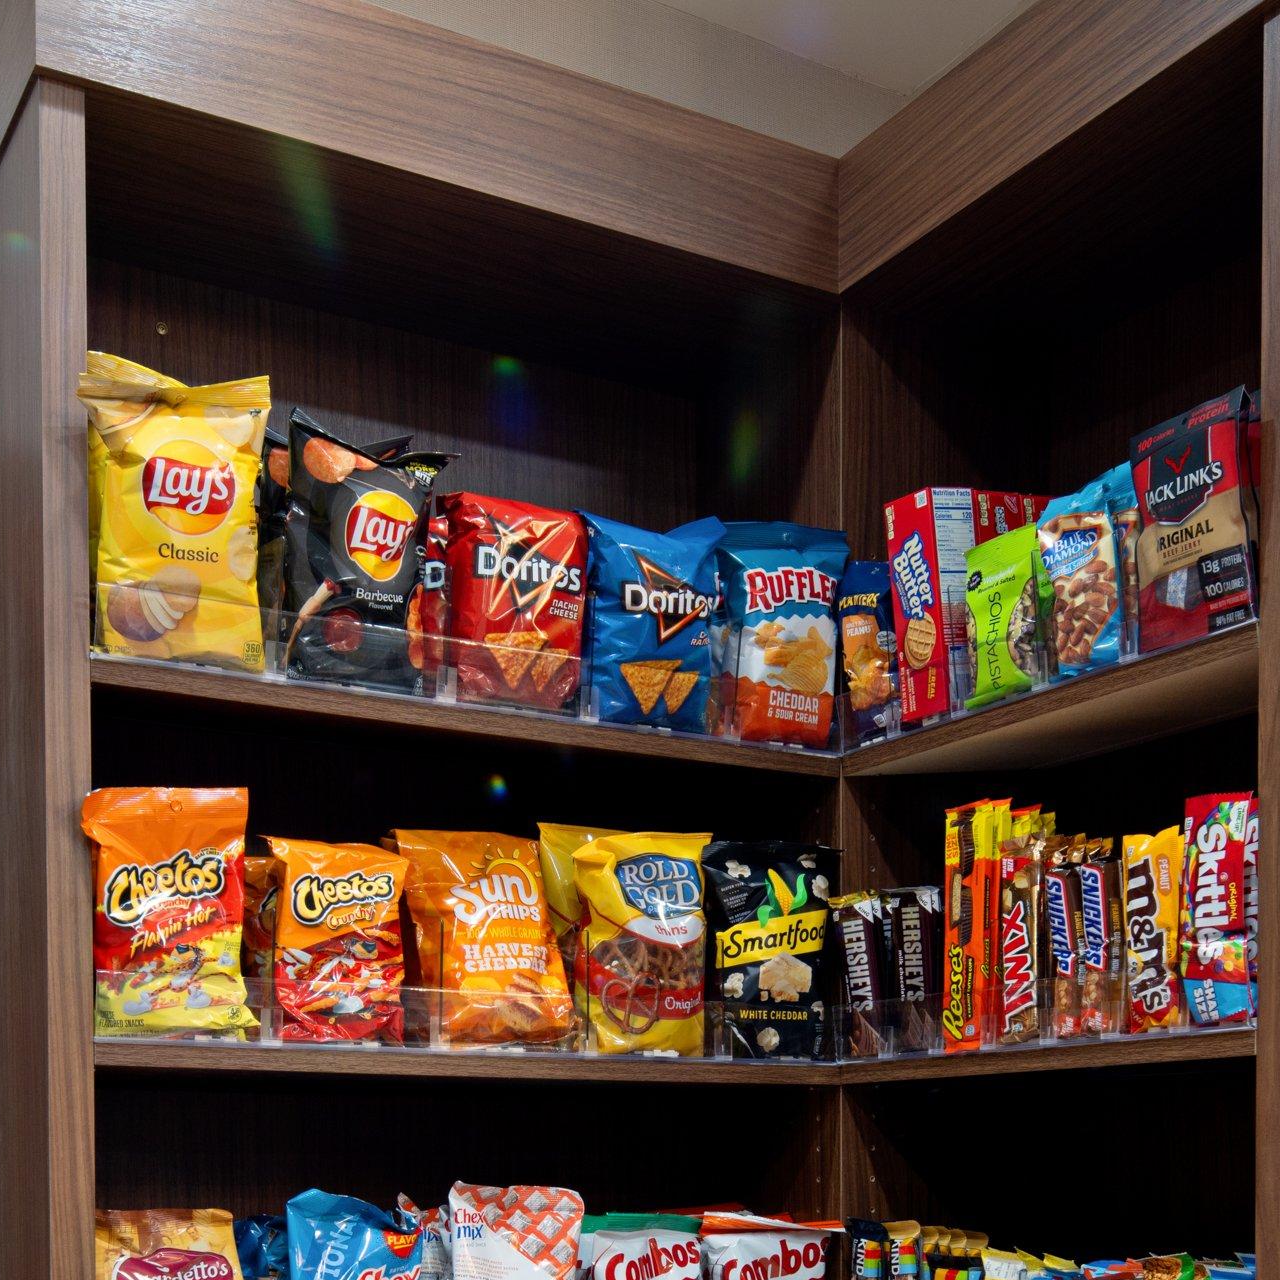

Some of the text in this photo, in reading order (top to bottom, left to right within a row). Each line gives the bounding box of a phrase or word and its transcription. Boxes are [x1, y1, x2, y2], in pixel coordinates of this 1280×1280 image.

[148, 458, 234, 514] Lay's
[1177, 462, 1223, 496] LINK'S
[158, 543, 219, 563] Classic
[1055, 531, 1083, 553] BLUE
[478, 545, 581, 592] Doritos
[904, 534, 932, 605] Nutter
[1202, 559, 1220, 573] 13g
[356, 588, 403, 603] Barbecue
[839, 593, 879, 610] PLANTERS
[893, 553, 924, 619] Butter
[1204, 584, 1223, 597] 100
[369, 602, 393, 610] Flavored
[549, 607, 578, 619] CHEESE
[553, 600, 579, 611] NACHO
[245, 644, 261, 653] 360
[986, 591, 1005, 689] PISTACHIOS
[768, 706, 818, 724] & SOUR CREAM
[770, 690, 818, 712] CHEDDAR
[107, 854, 222, 923] Cheetos
[621, 861, 689, 885] ROLD
[1158, 859, 1169, 890] PEANUT
[294, 872, 395, 924] Cheetos
[449, 875, 538, 925] Sun
[625, 879, 700, 910] GOLD
[1195, 824, 1229, 965] Skittles
[488, 903, 540, 922] CHIPS
[842, 919, 873, 1011] HERSHEY'S
[901, 906, 925, 1001] HERSHEY'S
[1003, 901, 1033, 1033] TWIX
[943, 944, 963, 1039] Reese's
[1193, 987, 1209, 1022] SIZE
[1203, 978, 1219, 1022] SHARE
[125, 1019, 145, 1028] SNACKS
[740, 1010, 808, 1020] WHITE CHEDDAR
[455, 1208, 484, 1224] Chex
[457, 1225, 483, 1240] mix
[856, 1238, 867, 1275] KIND
[891, 1239, 903, 1275] KIND
